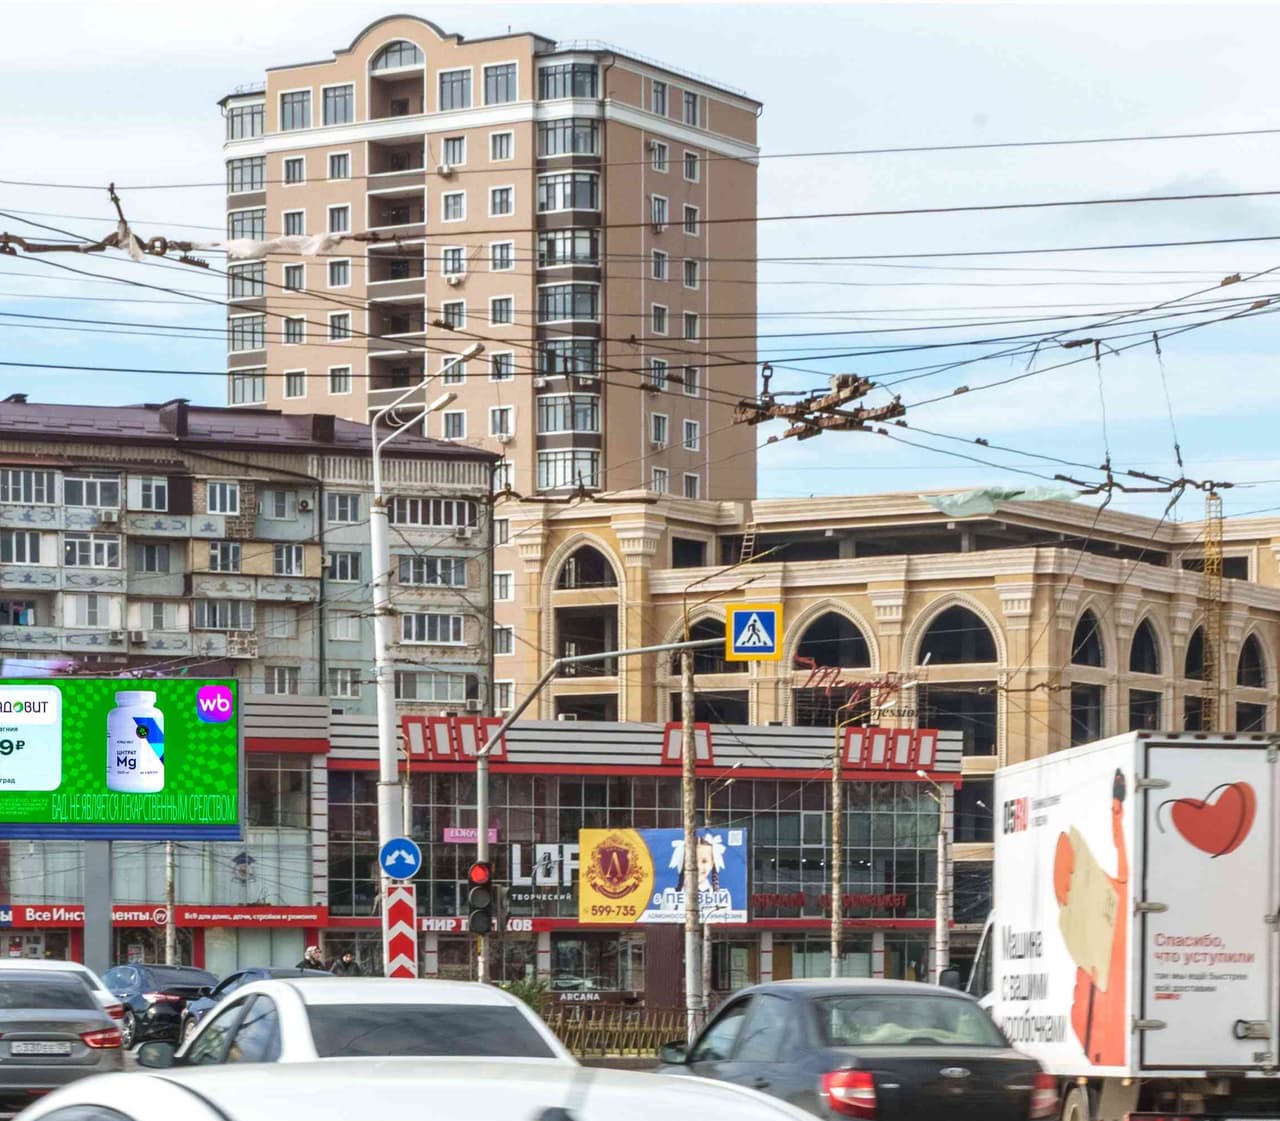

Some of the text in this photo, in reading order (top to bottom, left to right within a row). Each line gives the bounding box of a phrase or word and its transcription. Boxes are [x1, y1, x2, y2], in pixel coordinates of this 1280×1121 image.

[200, 693, 230, 712] wb
[117, 756, 137, 769] Mg
[71, 795, 80, 820] НЕ
[81, 794, 119, 821] ЯВЛЯЕТСЯ
[119, 794, 188, 821] ЛЕКАРСТВЕННЫМ
[189, 794, 235, 822] СРЕДСТВОМ
[512, 892, 572, 901] ТВОРЧЕСКИЙ
[666, 891, 729, 904] ПЕВЫЙ
[25, 908, 51, 921] Все
[591, 905, 636, 916] 599-735
[422, 919, 457, 931] МИР
[1153, 952, 1180, 962] что
[560, 993, 601, 1001] ARCANA
